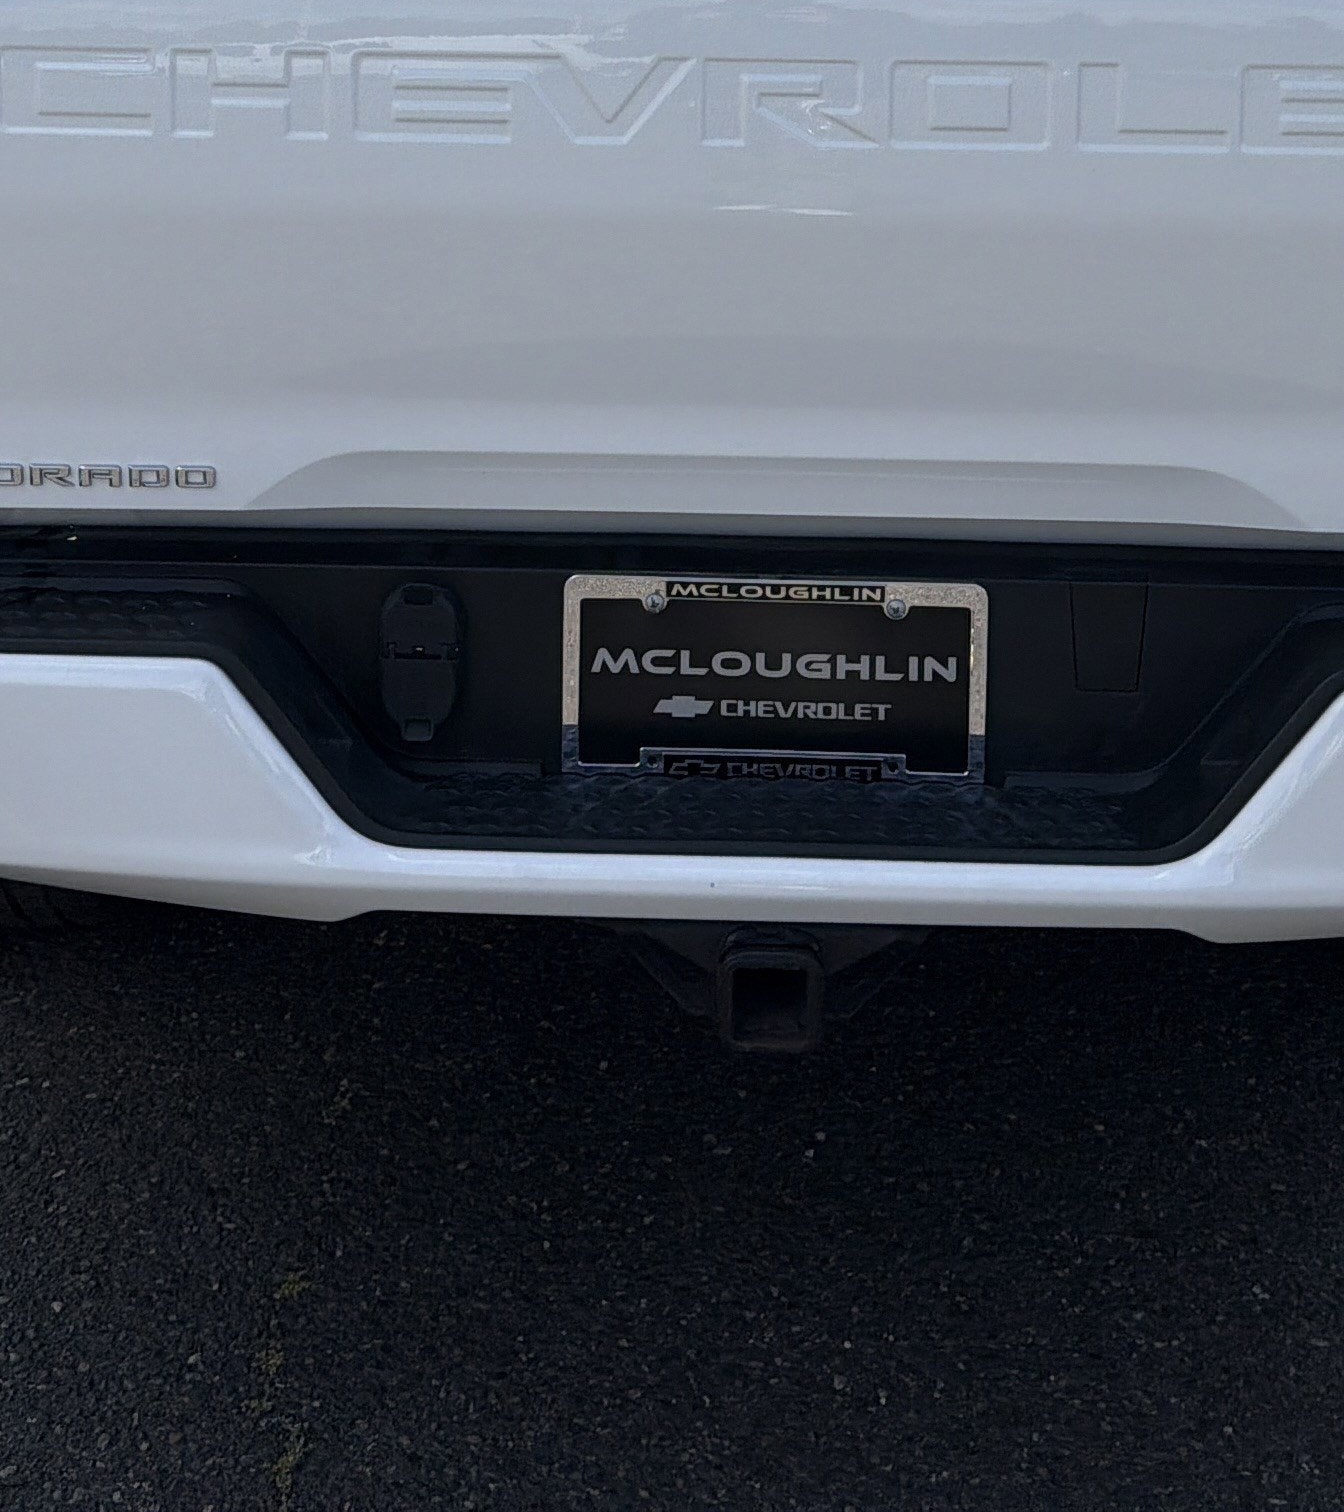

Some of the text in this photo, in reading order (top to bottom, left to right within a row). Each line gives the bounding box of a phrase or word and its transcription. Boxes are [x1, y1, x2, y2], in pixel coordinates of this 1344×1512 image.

[669, 582, 884, 602] MCLOUGHLIN
[590, 646, 957, 683] MCLOUGHLIN
[719, 698, 892, 722] CHEVROLET
